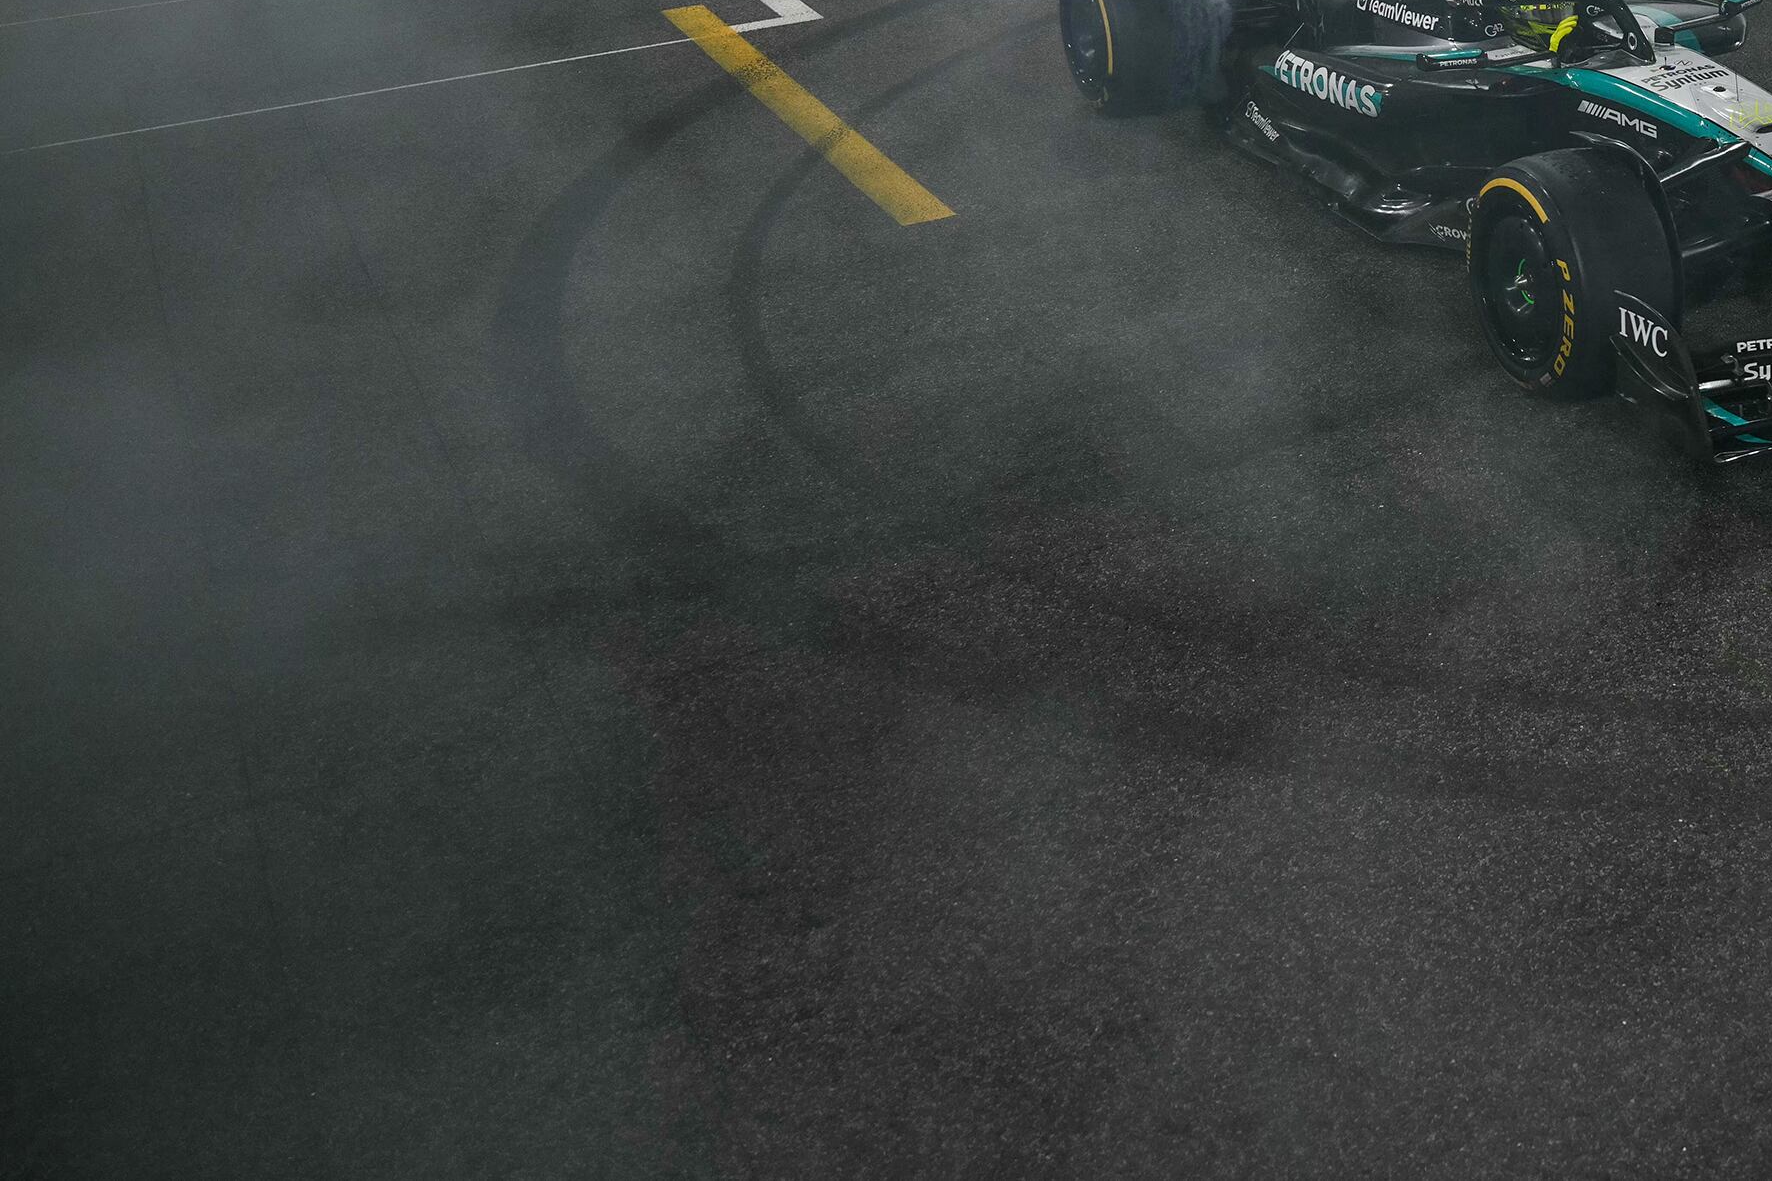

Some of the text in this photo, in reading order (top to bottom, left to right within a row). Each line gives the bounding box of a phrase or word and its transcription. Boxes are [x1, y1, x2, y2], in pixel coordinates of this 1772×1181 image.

[1485, 23, 1505, 36] G42
[1440, 58, 1477, 68] PETRONAS
[1641, 65, 1716, 84] PETRONAS
[1275, 50, 1379, 118] PETRONAS
[1650, 69, 1730, 92] Syntium
[1602, 108, 1658, 139] AMG
[1553, 259, 1575, 377] P ZERO
[1619, 306, 1668, 358] IWC
